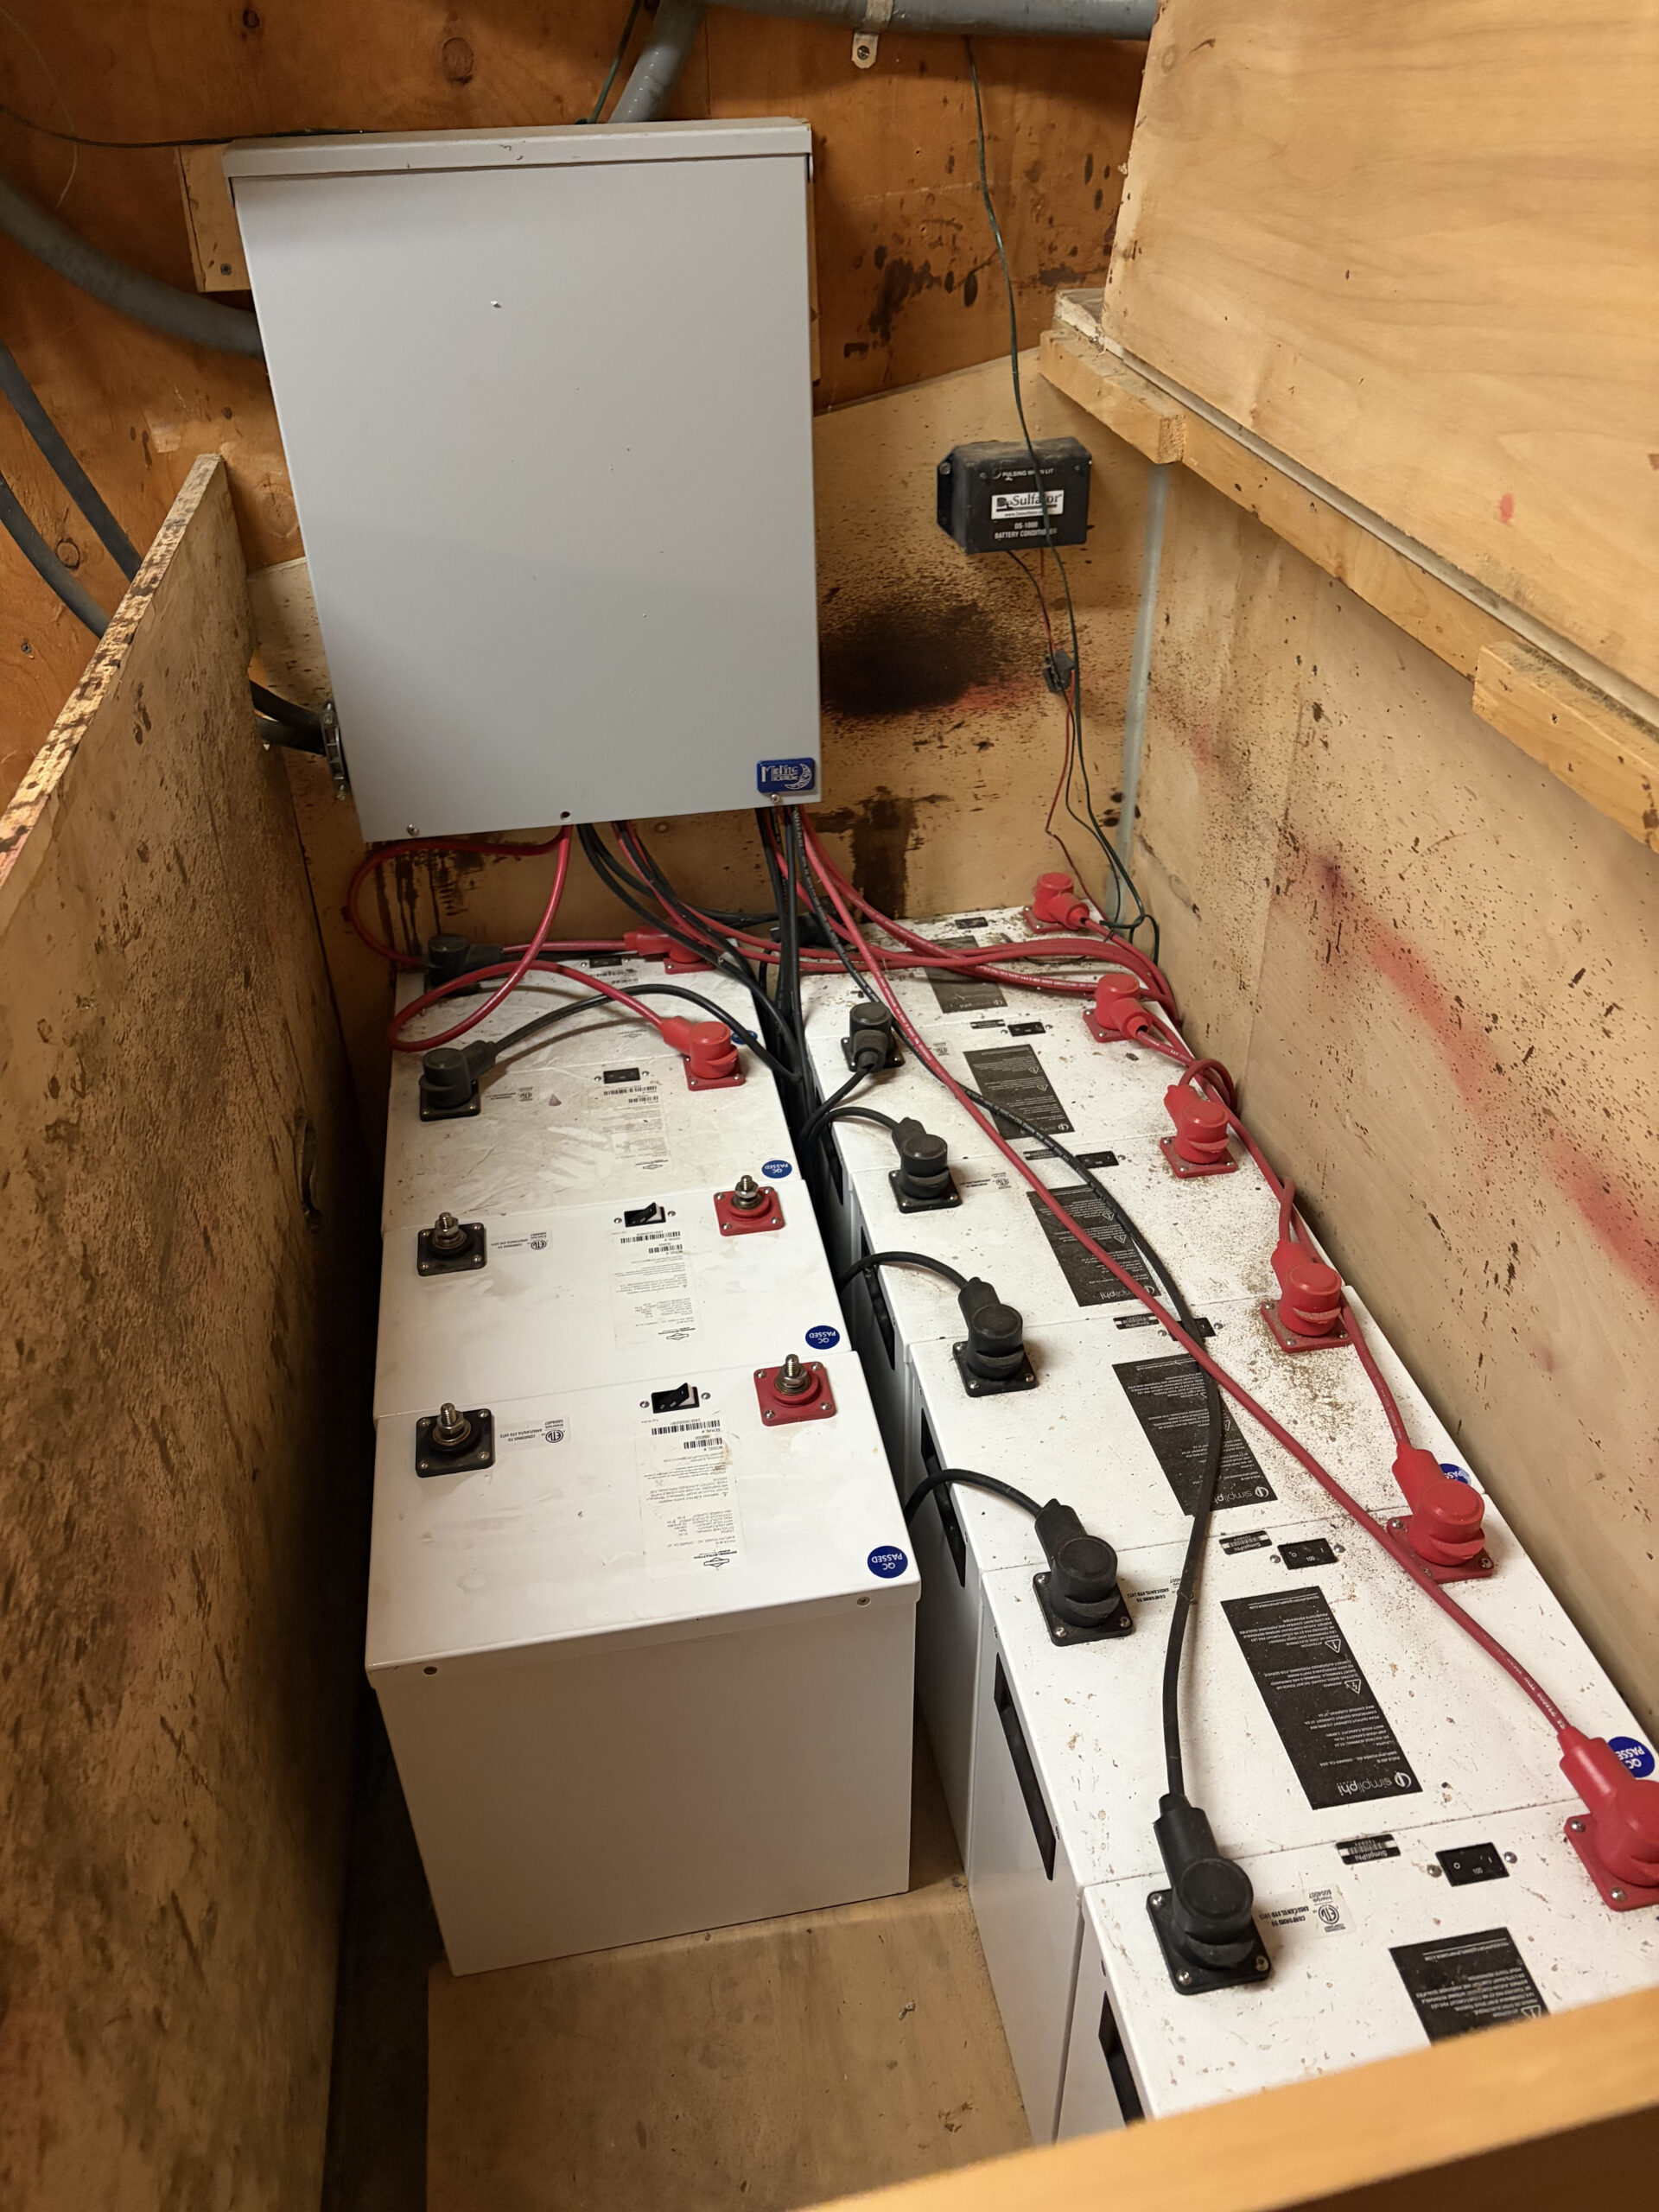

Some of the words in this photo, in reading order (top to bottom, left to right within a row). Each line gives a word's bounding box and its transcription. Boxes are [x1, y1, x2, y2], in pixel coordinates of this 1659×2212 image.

[1020, 528, 1057, 537] CONDITIOER
[871, 1553, 902, 1563] PASSED
[1615, 1745, 1645, 1760] PASSE
[1625, 1758, 1642, 1769] QC
[1337, 1777, 1393, 1796] simpliphi
[1355, 1849, 1388, 1861] SimpliPhi
[1279, 1916, 1306, 1926] CONFORMS
